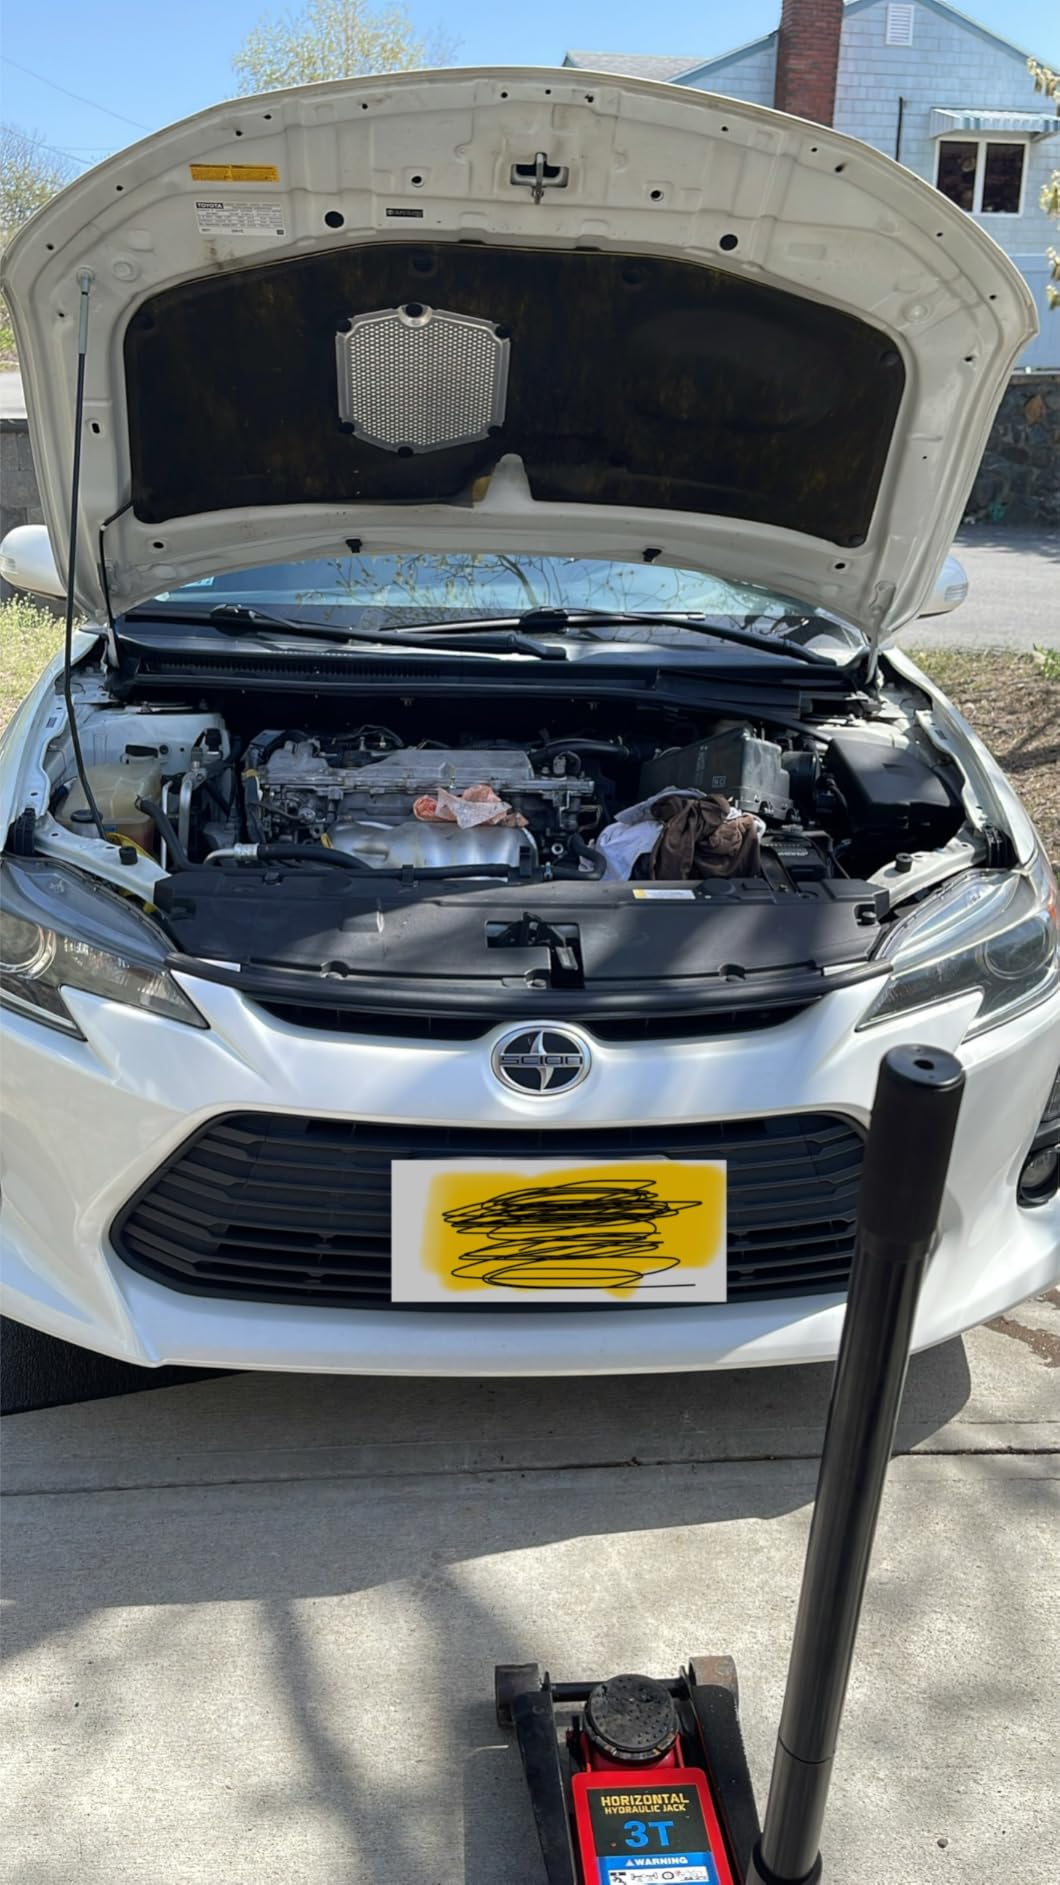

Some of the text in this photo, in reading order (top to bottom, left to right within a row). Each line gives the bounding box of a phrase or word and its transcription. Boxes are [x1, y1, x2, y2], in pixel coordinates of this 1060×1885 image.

[500, 1055, 583, 1066] SCION
[601, 1793, 690, 1807] HORIZONTAL
[604, 1803, 687, 1815] HYDRAULIC JACK
[624, 1820, 674, 1848] 3T
[634, 1857, 688, 1866] WARNING
